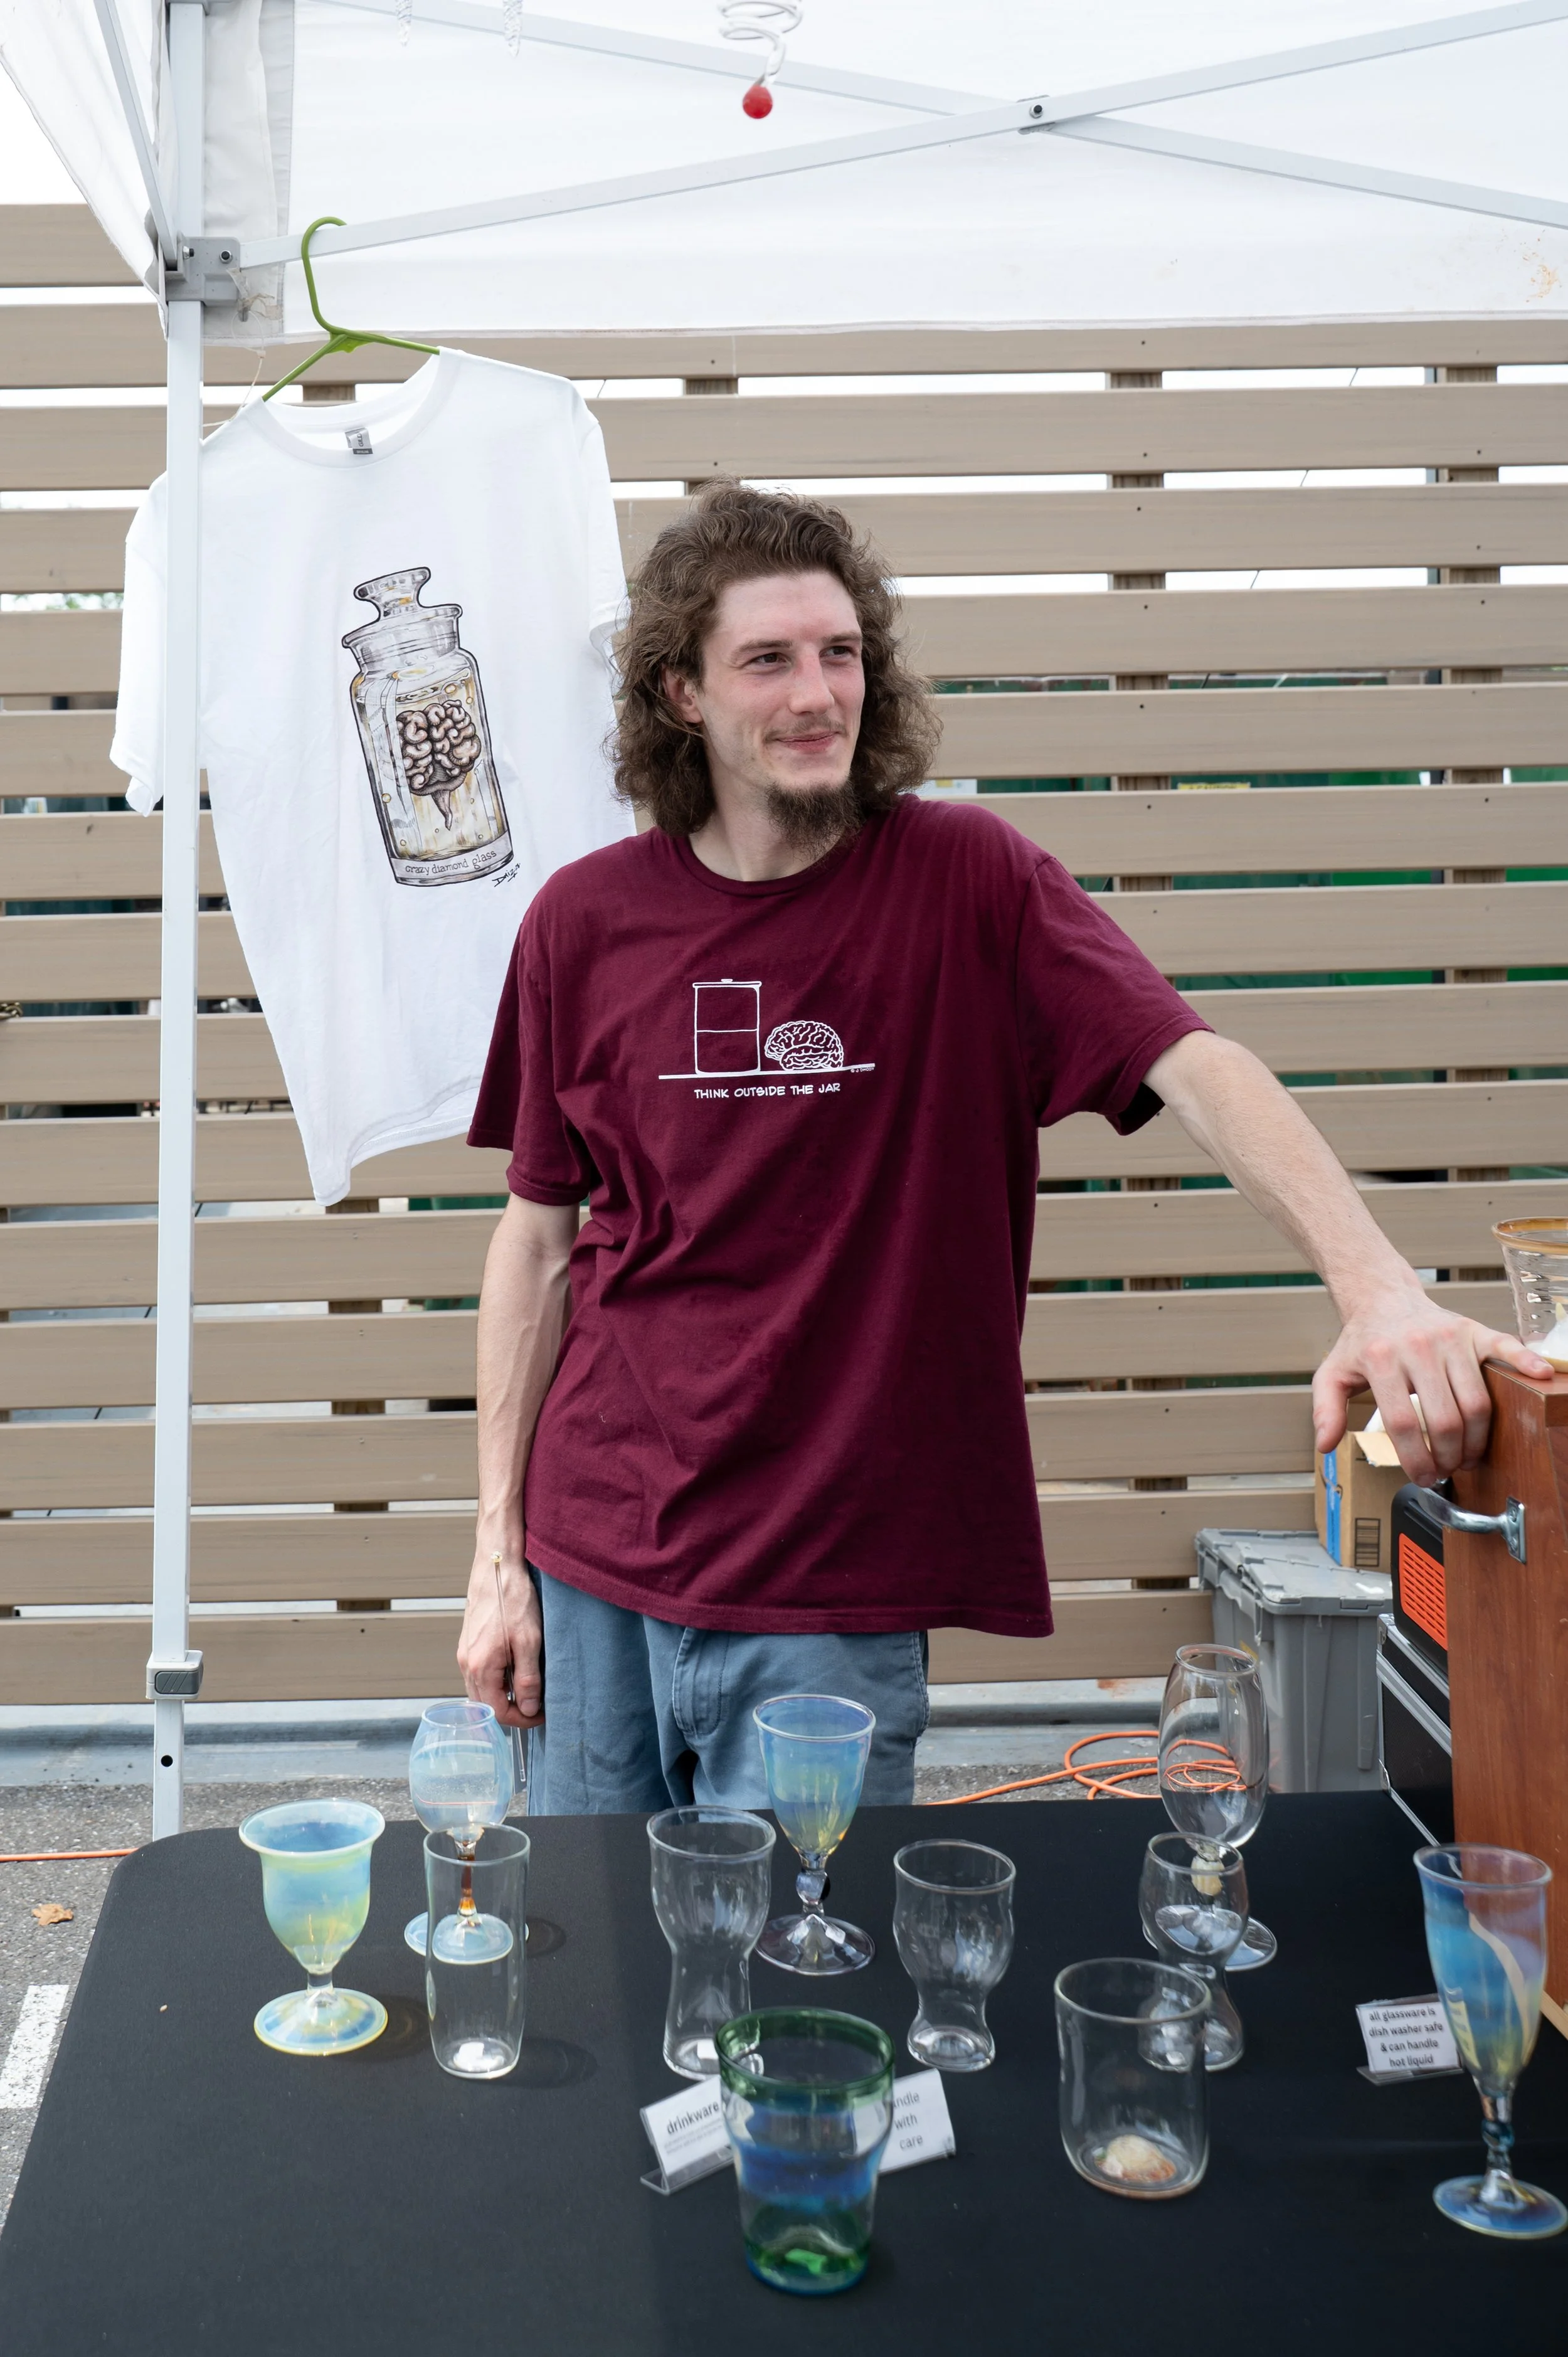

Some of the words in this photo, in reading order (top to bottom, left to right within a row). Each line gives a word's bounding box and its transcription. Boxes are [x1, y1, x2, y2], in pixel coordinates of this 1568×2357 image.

[405, 866, 430, 876] crazy
[432, 858, 469, 874] diamond
[472, 850, 497, 870] glass
[694, 1088, 729, 1099] THINK
[734, 1086, 785, 1098] OUTSIDE
[790, 1084, 813, 1095] THE
[818, 1083, 840, 1093] JAR
[1369, 2010, 1381, 2021] all
[1382, 2009, 1426, 2023] glassware
[1427, 2005, 1436, 2016] is
[1369, 2026, 1389, 2038] dish
[1390, 2023, 1422, 2035] washer
[1423, 2020, 1443, 2033] safe
[1380, 2042, 1388, 2052] &
[1388, 2042, 1406, 2052] can
[1406, 2037, 1439, 2050] handle
[1389, 2057, 1406, 2067] hot
[1406, 2053, 1434, 2068] liquid
[893, 2090, 920, 2108] ndle
[666, 2101, 719, 2135] drinkware
[894, 2112, 918, 2131] with
[899, 2134, 924, 2151] care
